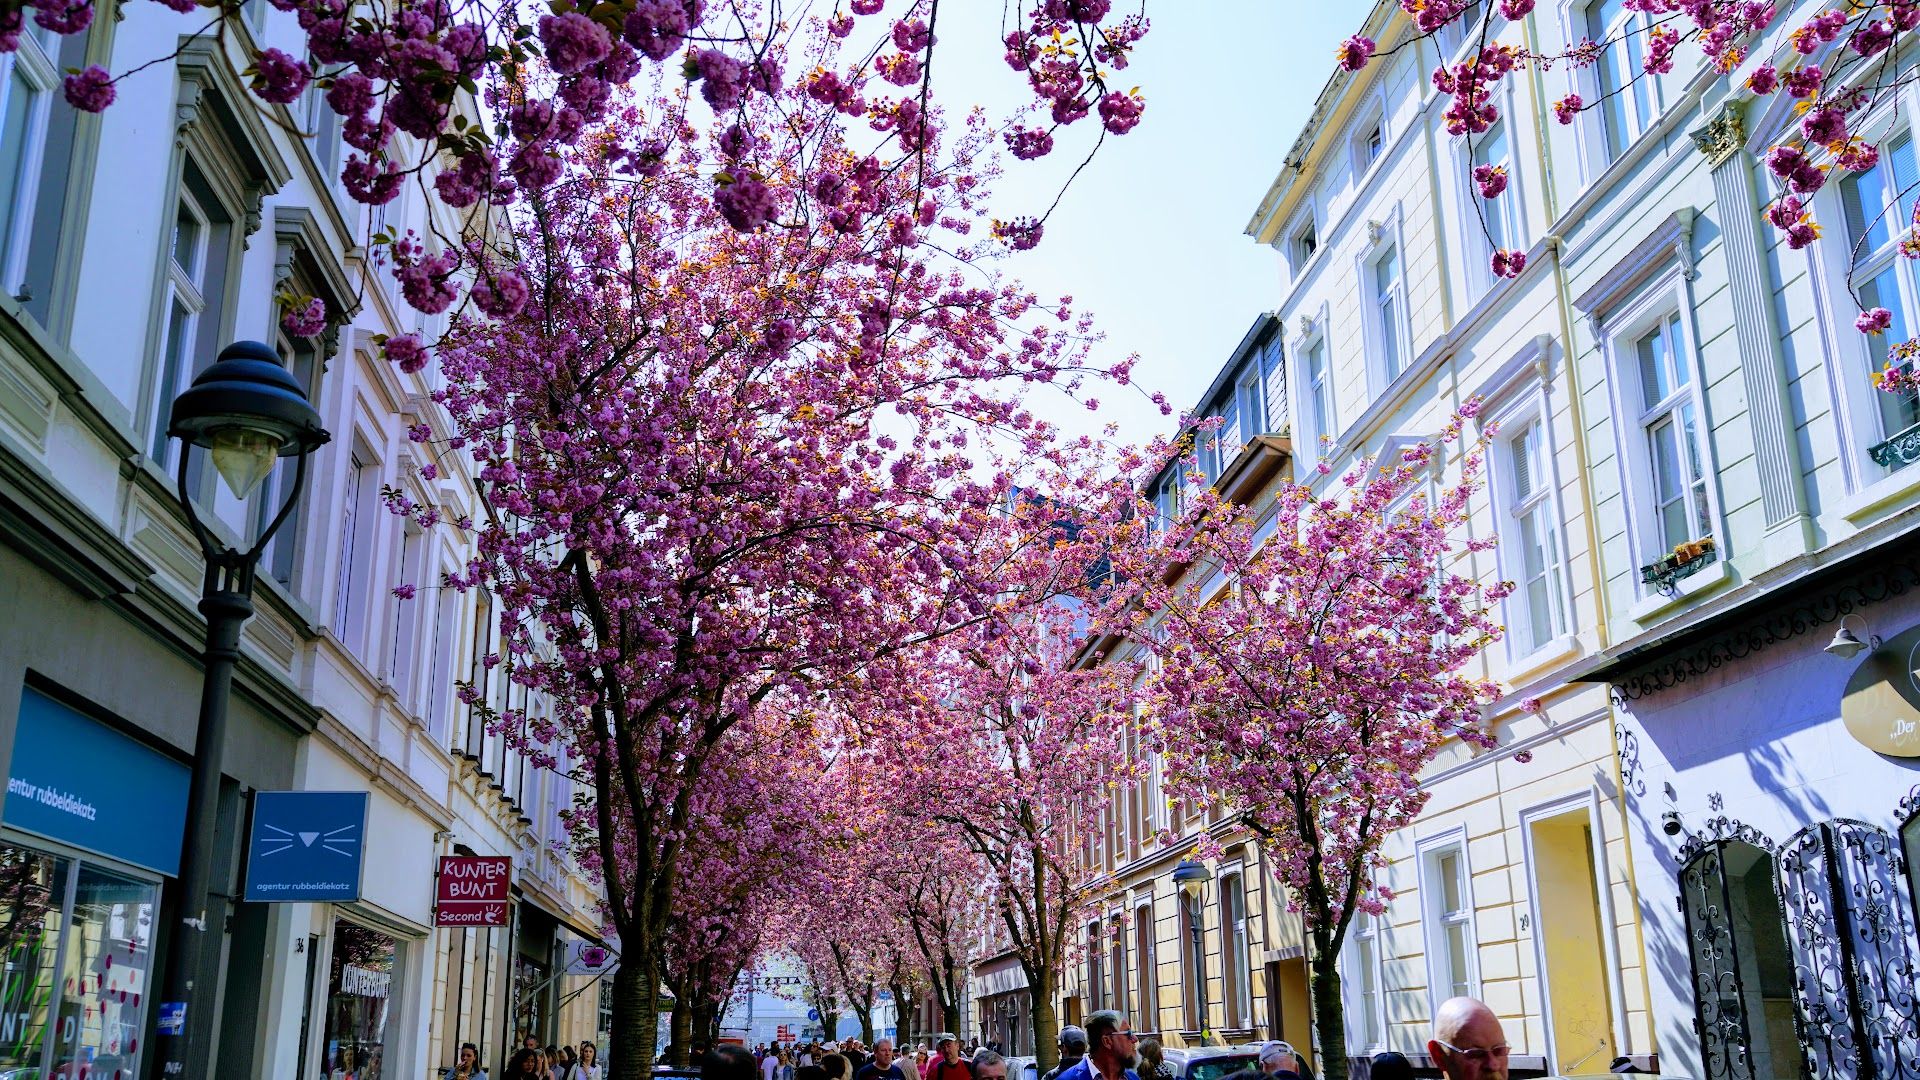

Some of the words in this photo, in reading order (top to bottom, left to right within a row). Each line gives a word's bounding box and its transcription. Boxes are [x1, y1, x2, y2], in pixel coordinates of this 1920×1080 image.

[7, 777, 37, 799] entur
[37, 785, 97, 821] rubbeldiekatz
[443, 860, 507, 880] KUNTER
[256, 882, 291, 892] agentur
[292, 881, 350, 890] rubbeldiekatz
[449, 880, 498, 899] BUNT
[438, 910, 483, 922] Second
[1519, 914, 1529, 931] 29
